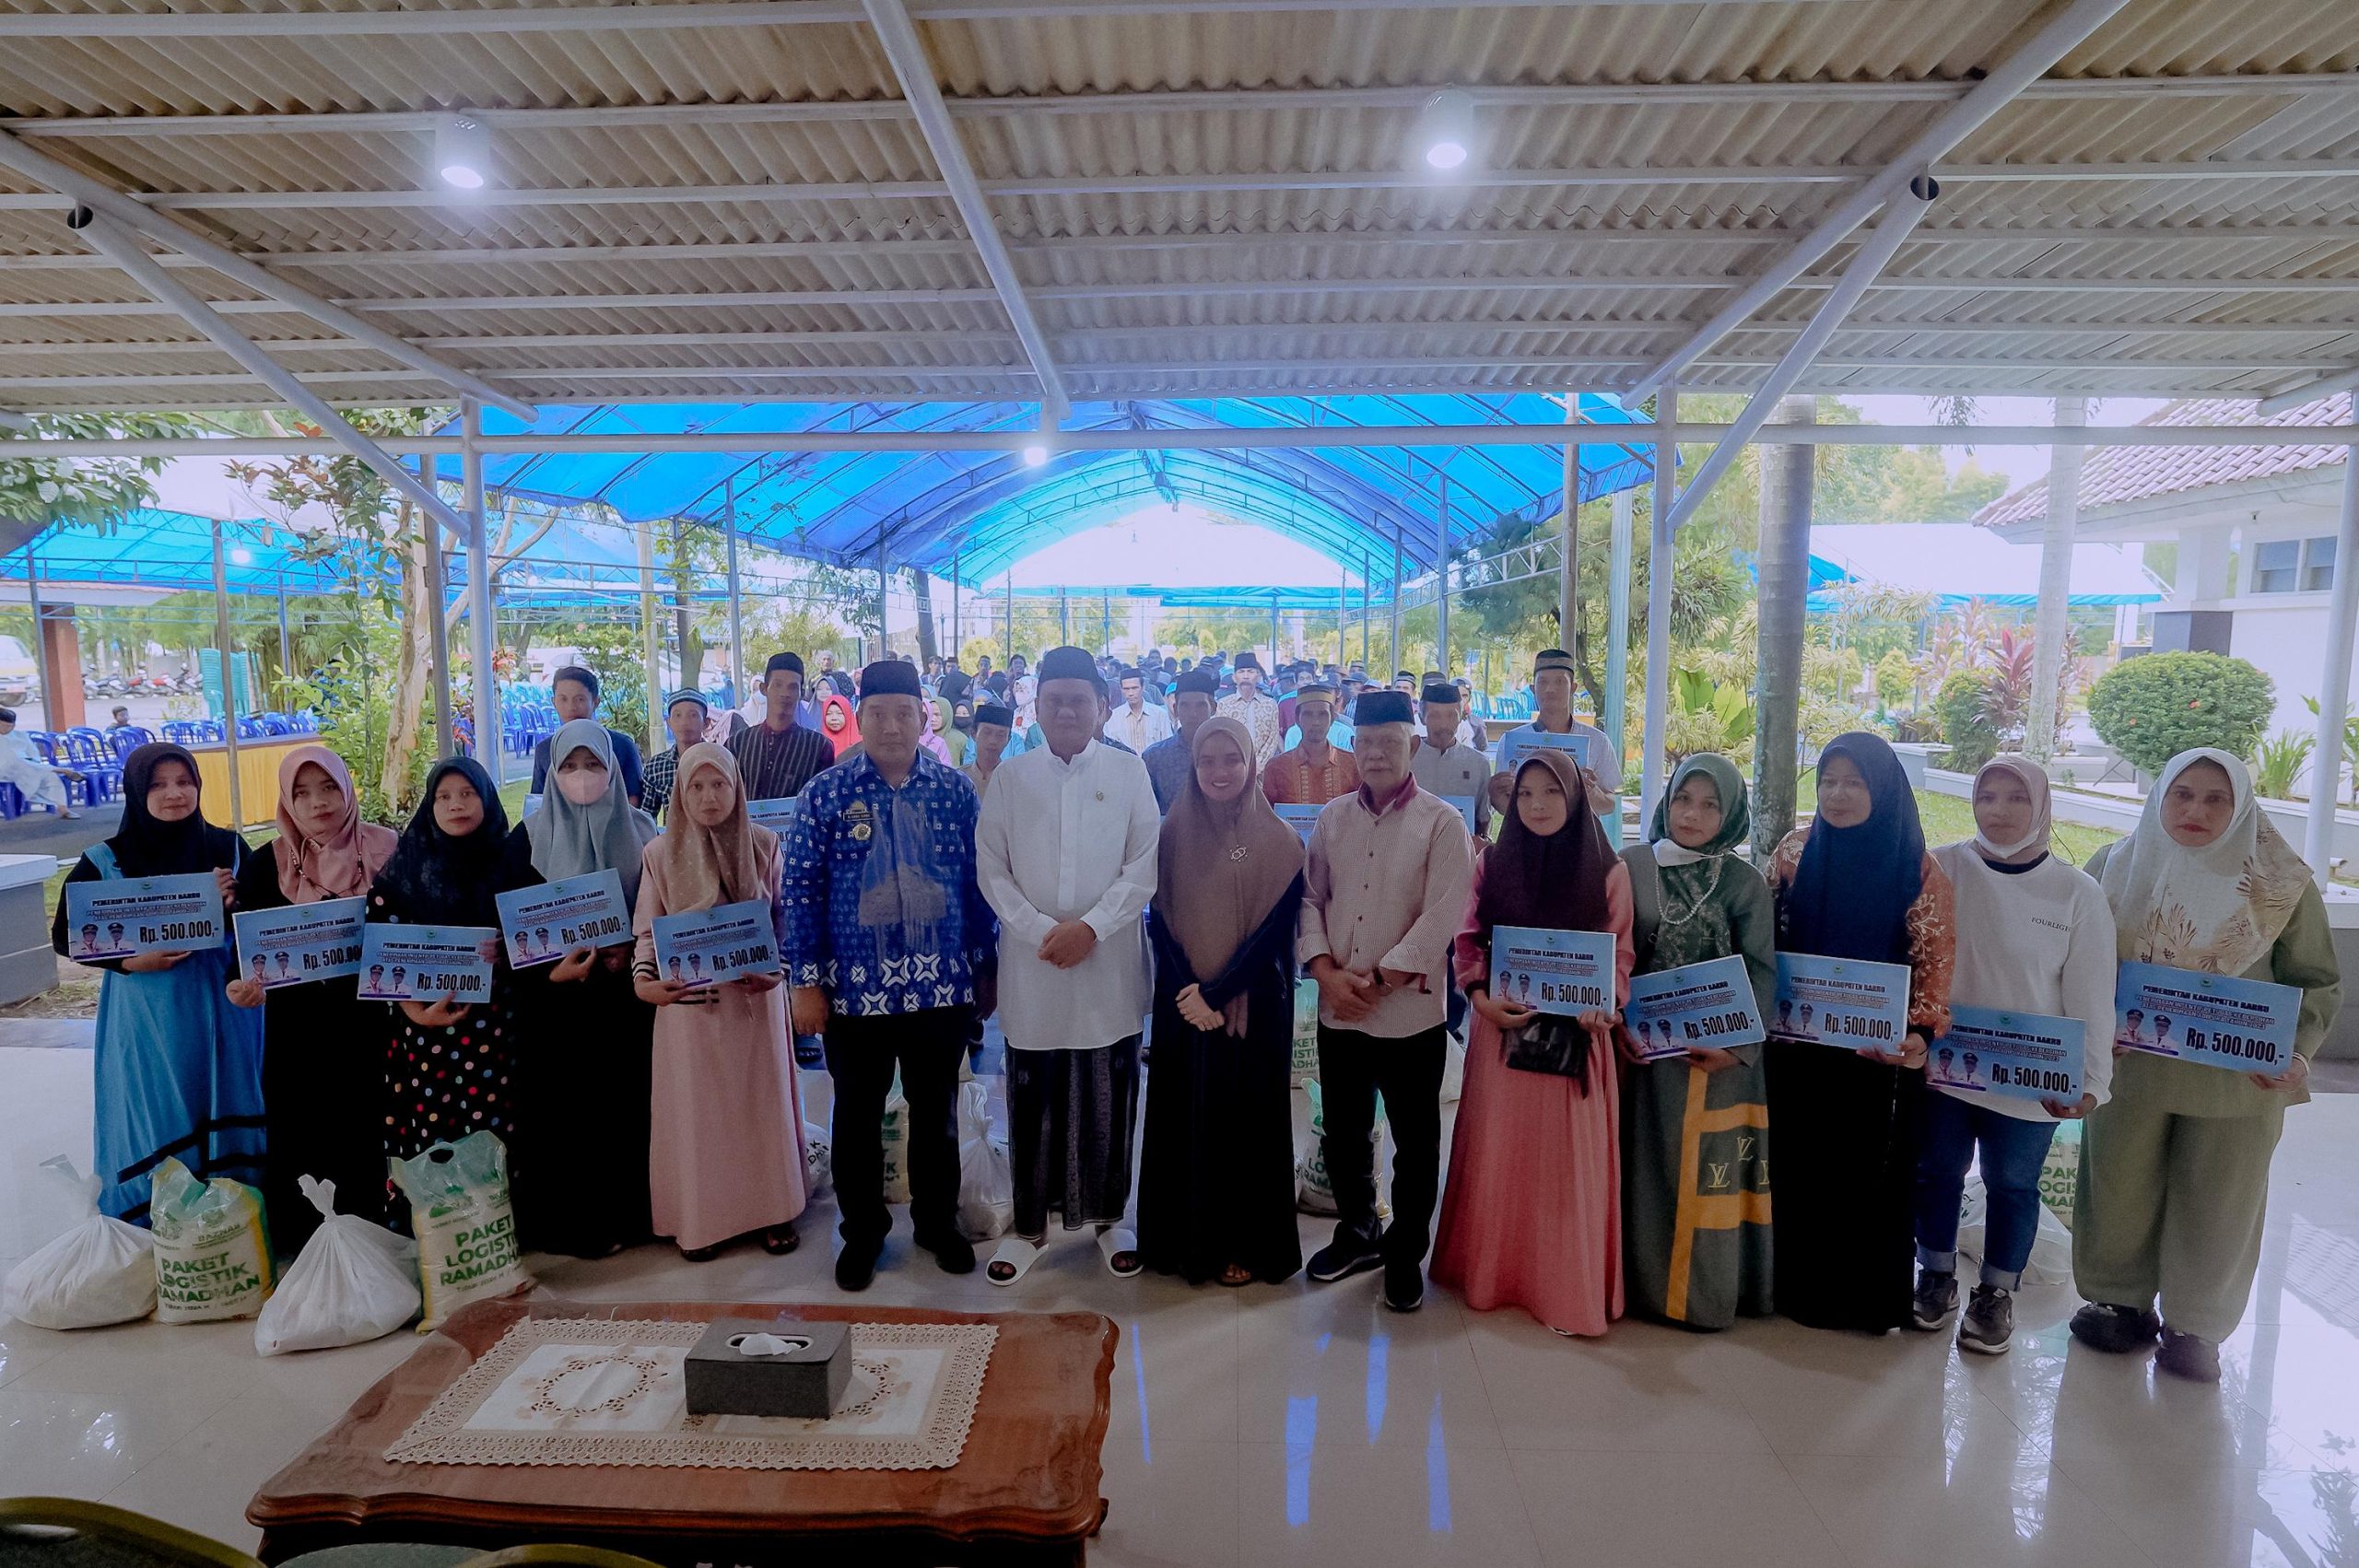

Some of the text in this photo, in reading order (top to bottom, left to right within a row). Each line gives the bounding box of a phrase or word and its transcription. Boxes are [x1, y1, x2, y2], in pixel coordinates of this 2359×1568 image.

[139, 920, 219, 944] Rp. 500.000,-
[561, 928, 579, 945] Rp.
[579, 916, 626, 941] 500.000,-
[302, 953, 321, 970] Rp.
[711, 944, 774, 972] Rp. 500.000,-
[417, 972, 487, 992] Rp. 500.000,-
[1541, 982, 1607, 1008] Rp. 500.000,-
[1683, 1011, 1755, 1040] Rp. 500.000,-
[1825, 1012, 1898, 1042] Rp. 500.000,-
[2186, 1026, 2284, 1066] Rp. 500.000,-
[1991, 1063, 2077, 1095] Rp. 500.000,-
[455, 1213, 511, 1247] PAKET
[161, 1252, 229, 1273] PAKET
[444, 1232, 517, 1268] LOGISTI
[440, 1251, 518, 1286] RAMADH
